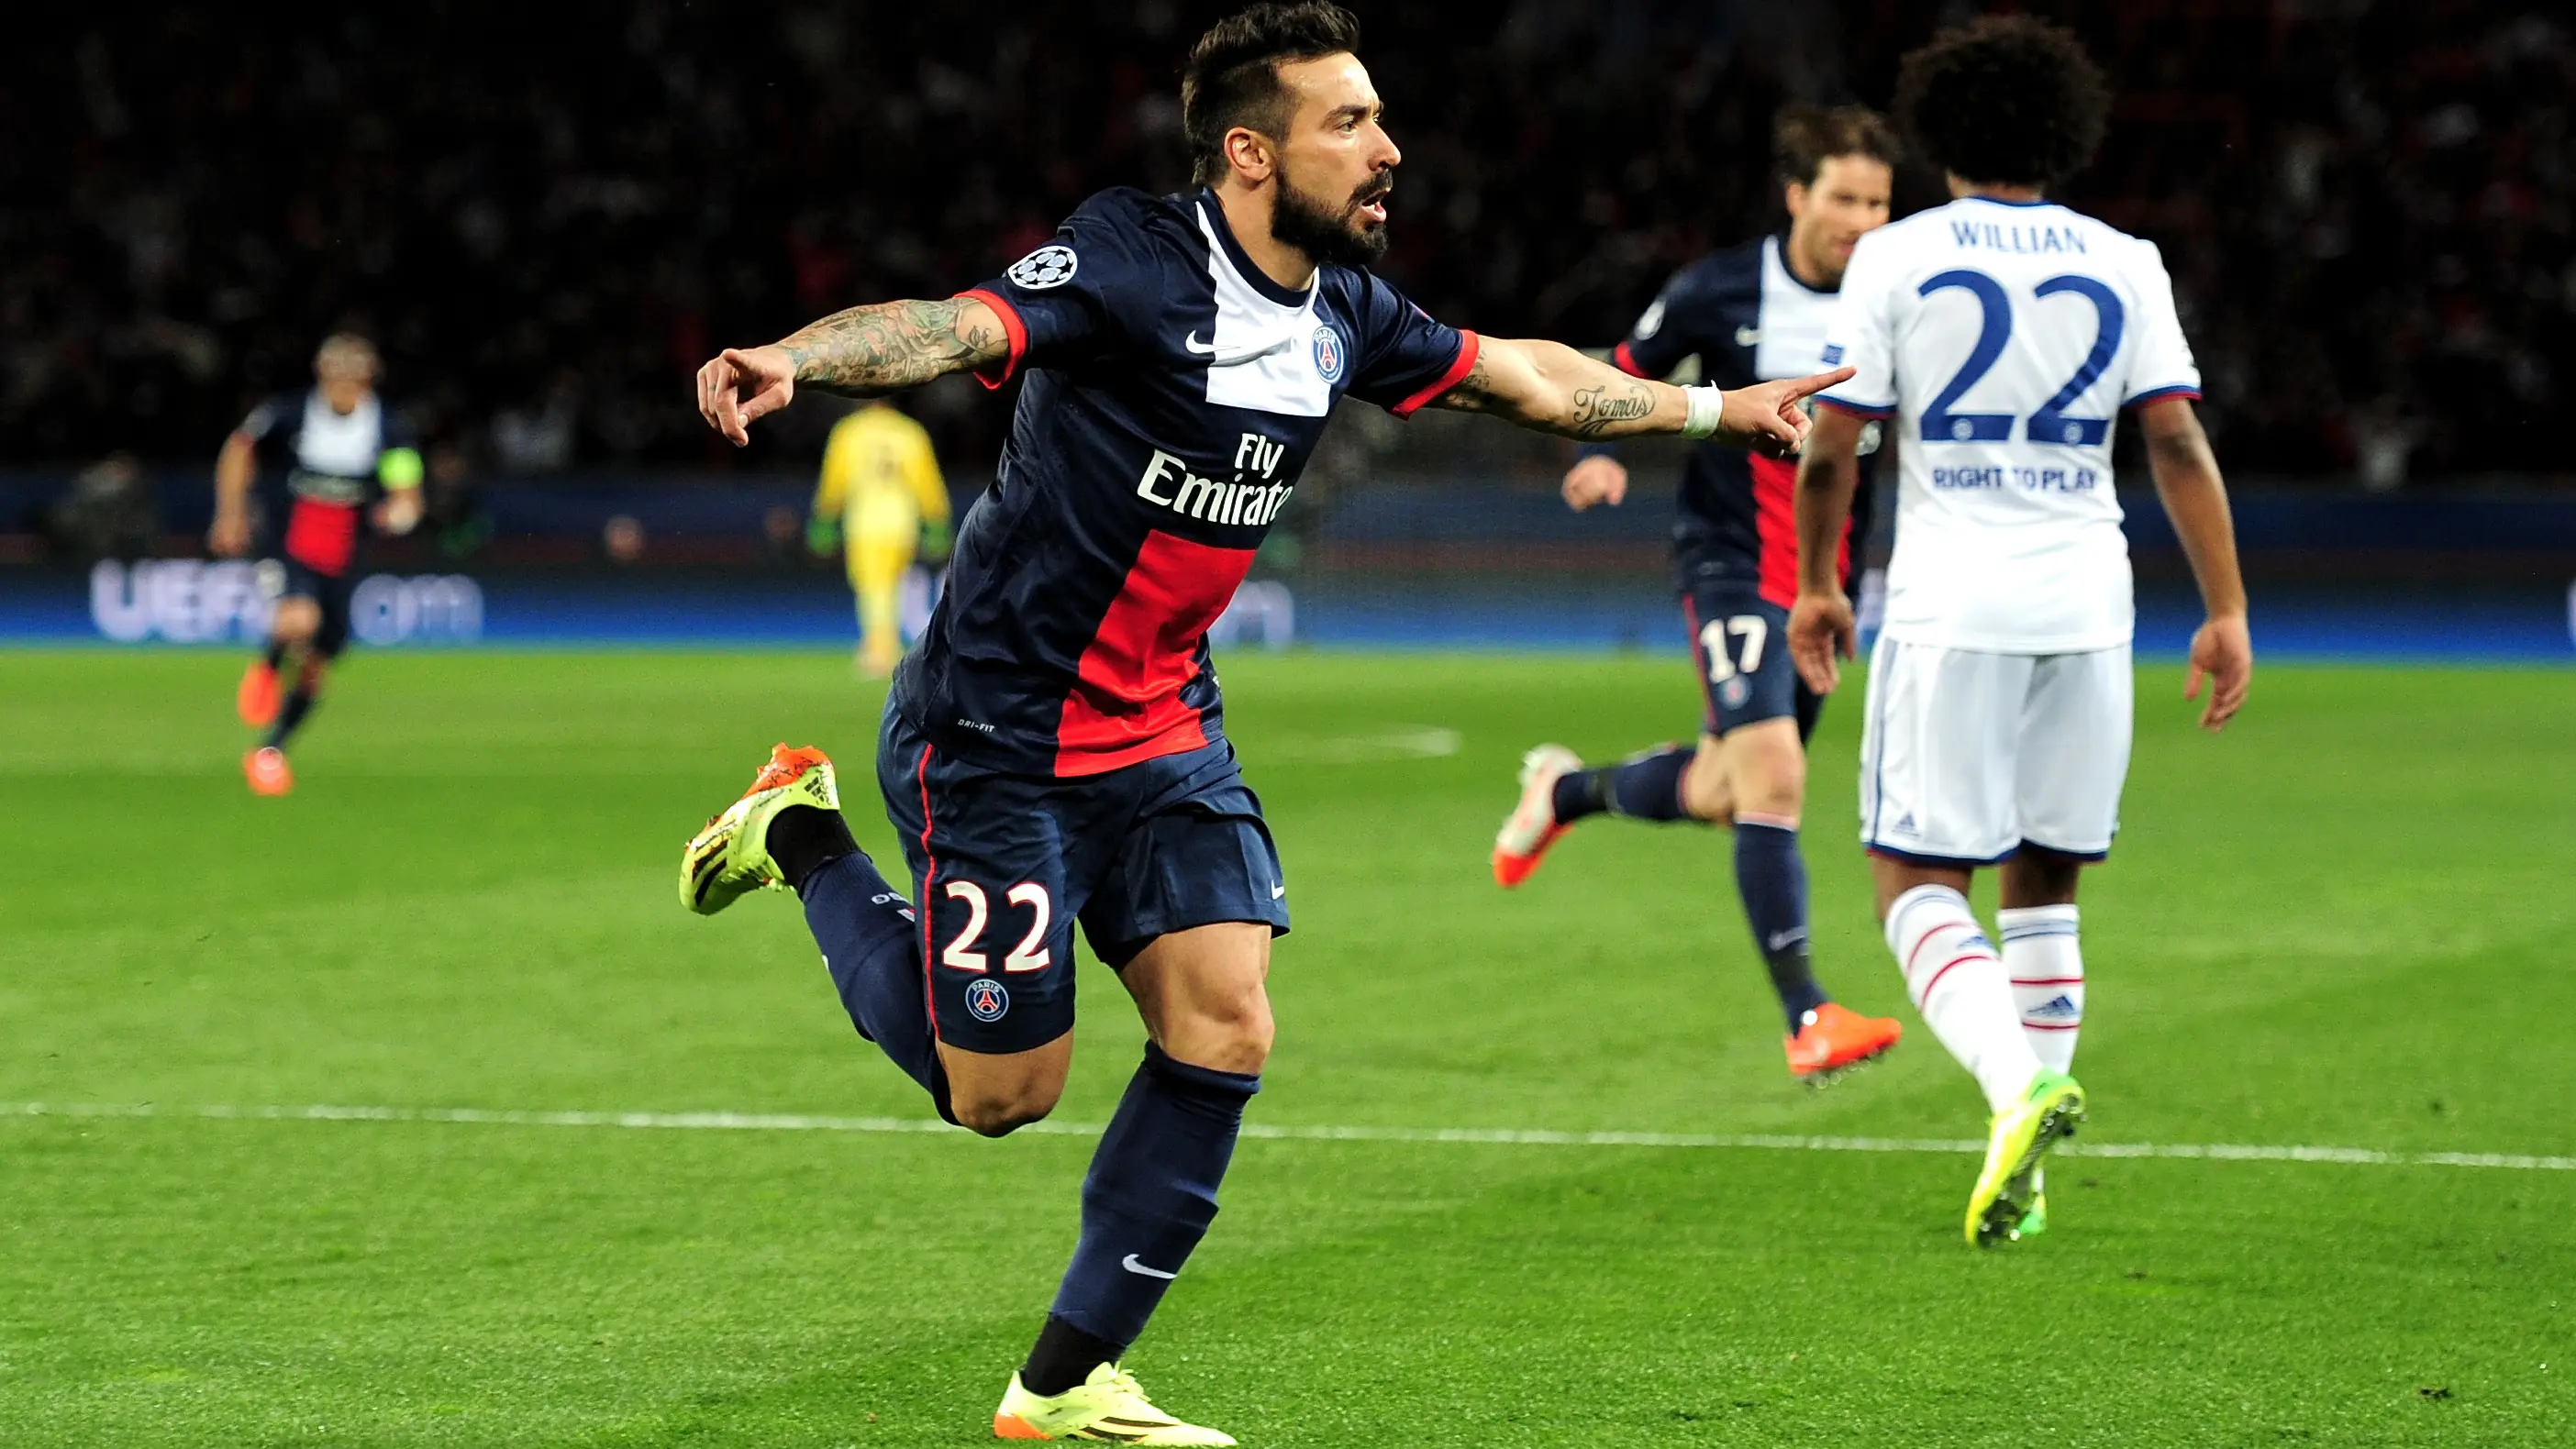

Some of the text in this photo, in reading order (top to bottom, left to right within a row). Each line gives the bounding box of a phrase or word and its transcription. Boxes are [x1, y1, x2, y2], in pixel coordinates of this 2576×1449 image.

[1949, 219, 2086, 254] WILLIAN
[1917, 270, 2125, 446] 22
[1573, 384, 1655, 425] Tomas
[1235, 433, 1284, 479] Fly
[1137, 448, 1294, 525] Emirate
[1933, 467, 2097, 492] RIGHT TO PLAY
[1700, 614, 1767, 683] 17
[957, 718, 995, 733] DRI-FIT
[942, 880, 1051, 973] 22
[972, 980, 1000, 993] PARIS
